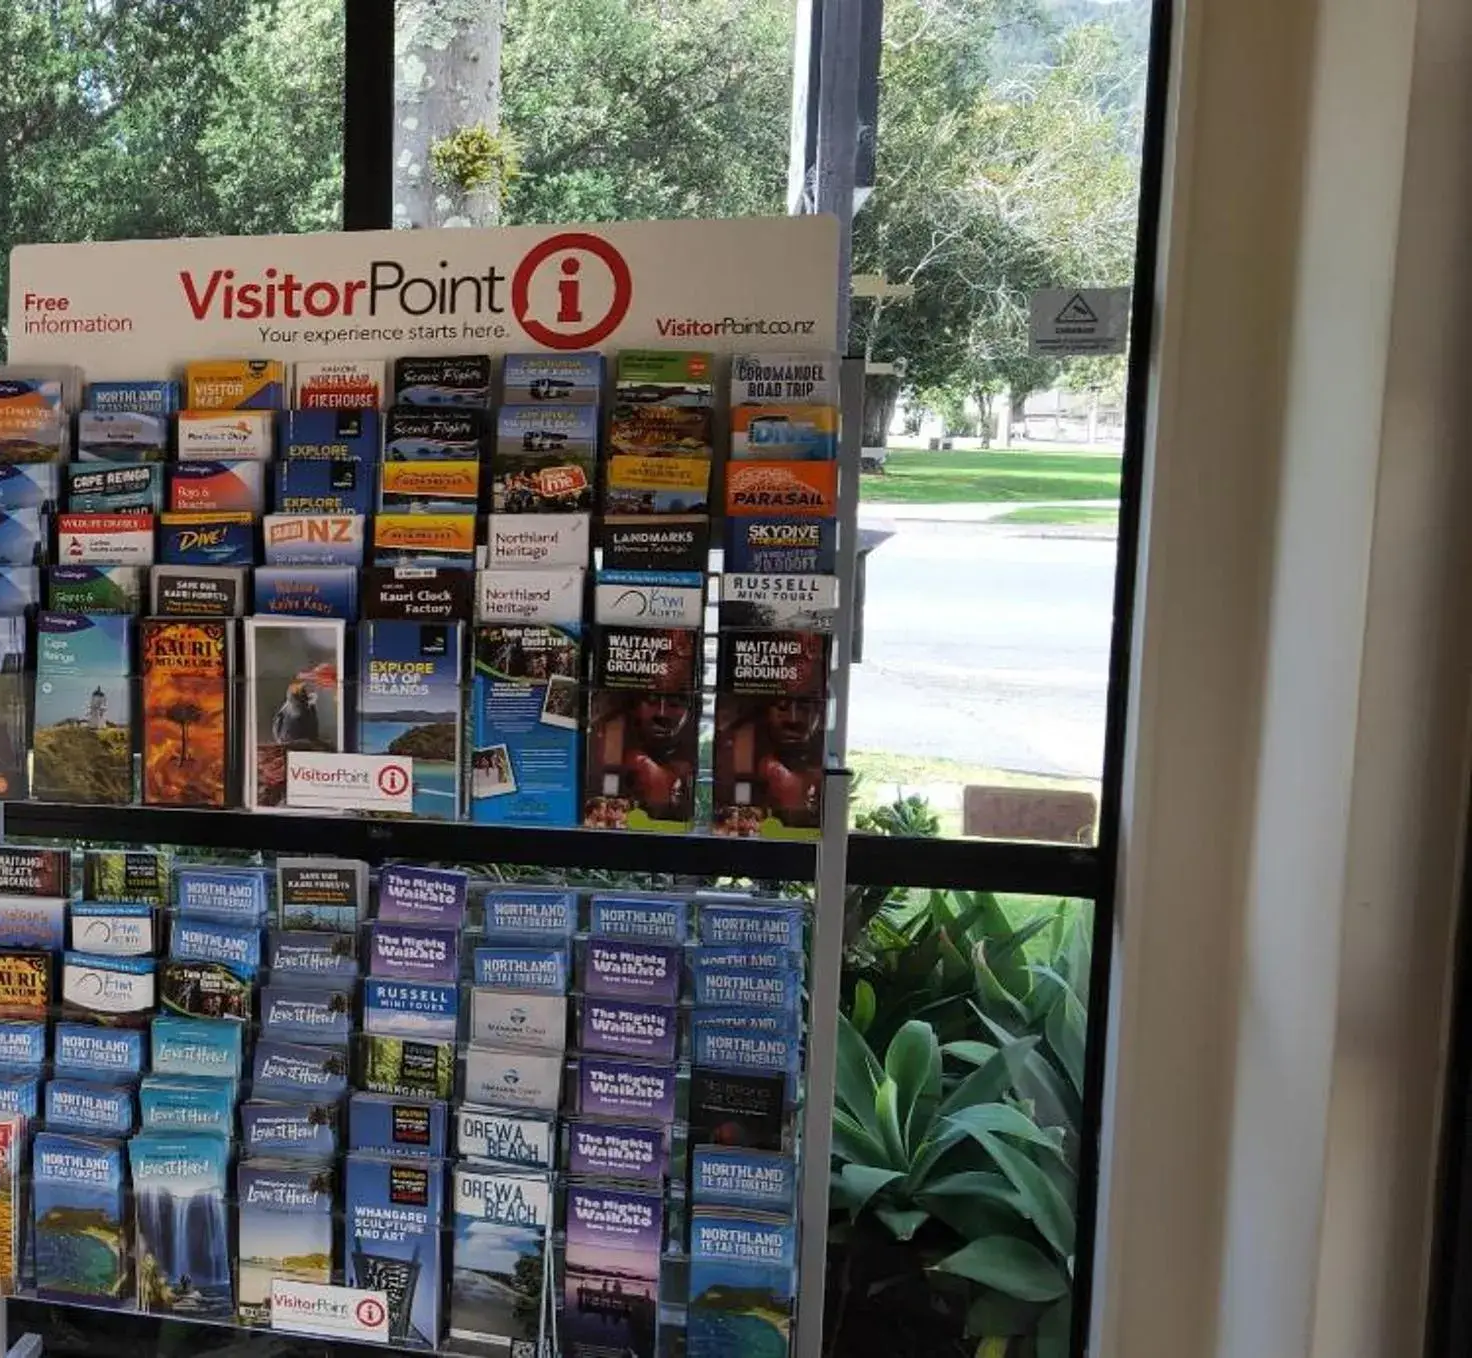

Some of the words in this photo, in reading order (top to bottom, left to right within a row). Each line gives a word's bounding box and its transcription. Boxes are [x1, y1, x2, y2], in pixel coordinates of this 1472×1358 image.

[180, 261, 505, 320] VisitorPoint
[24, 294, 70, 312] Free
[24, 315, 133, 335] information
[656, 317, 816, 337] VisitorPoint.co.nz
[259, 326, 296, 344] Your
[303, 325, 404, 345] experience
[409, 325, 458, 341] starts
[463, 323, 511, 339] here.
[403, 369, 440, 383] Scenic
[739, 365, 826, 382] COROMANDEL
[96, 390, 162, 403] NORTHLAND
[195, 383, 245, 396] VISITOR
[747, 381, 782, 397] ROAD
[787, 381, 814, 397] TRIP
[308, 394, 375, 408] FIREHOUSE
[393, 421, 430, 435] Scenic
[433, 421, 472, 439] Flights
[289, 445, 349, 456] EXPLORE
[73, 473, 104, 489] CAPE
[733, 492, 825, 506] PARASAIL
[307, 520, 353, 543] NZ
[495, 532, 559, 544] Northland
[613, 532, 694, 543] LANDMARKS
[747, 525, 820, 538] SKYDIVE
[495, 546, 549, 560] Heritage
[733, 577, 820, 591] RUSSELL
[379, 589, 413, 602] Kauri
[417, 589, 452, 602] Clock
[486, 588, 551, 602] Northland
[737, 591, 767, 600] MINI
[772, 592, 814, 601] TOURS
[405, 603, 452, 616] Factory
[486, 602, 539, 617] Heritage
[154, 640, 212, 656] KAURI
[608, 635, 672, 650] WAITANGI
[735, 641, 802, 654] WAITANGI
[154, 657, 213, 667] MUSEUM
[609, 648, 656, 660] TREATY
[736, 653, 786, 666] TREATY
[369, 661, 434, 674] EXPLORE
[607, 659, 668, 675] GROUNDS
[735, 667, 798, 680] GROUNDS
[370, 673, 398, 684] BAY
[402, 673, 422, 685] OF
[369, 684, 429, 695] ISLANDS
[290, 766, 369, 783] VisitorPoint
[186, 882, 252, 897] NORTHLAND
[388, 875, 410, 886] The
[412, 877, 455, 895] Mighty
[388, 886, 456, 904] Waikato
[494, 904, 565, 918] NORTHLAND
[600, 908, 676, 925] NORTHLAND
[712, 917, 790, 933] NORTHLAND
[377, 935, 398, 946] The
[401, 937, 446, 951] Mighty
[377, 945, 446, 961] Waikato
[592, 950, 616, 961] The
[619, 952, 666, 968] Mighty
[484, 959, 556, 974] NORTHLAND
[592, 961, 666, 977] Waikato
[706, 975, 784, 992] NORTHLAND
[377, 986, 448, 1003] RUSSELL
[706, 990, 716, 1000] TE
[719, 989, 734, 1000] TAI
[381, 1000, 406, 1010] MINI
[412, 1002, 445, 1012] TOURS
[592, 1008, 616, 1020] The
[619, 1010, 665, 1028] Mighty
[592, 1019, 666, 1037] Waikato
[62, 1036, 129, 1052] NORTHLAND
[706, 1035, 786, 1054] NORTHLAND
[590, 1071, 615, 1082] The
[618, 1073, 665, 1089] Mighty
[590, 1081, 664, 1099] Waikato
[53, 1092, 119, 1111] NORTHLAND
[463, 1119, 523, 1141] OREWA
[488, 1139, 538, 1161] BEACH
[578, 1133, 603, 1145] The
[605, 1135, 652, 1152] Mighty
[579, 1144, 653, 1162] Waikato
[42, 1153, 109, 1171] NORTHLAND
[702, 1161, 784, 1181] NORTHLAND
[461, 1178, 523, 1201] OREWA
[355, 1206, 427, 1223] WHANGAREI
[484, 1199, 537, 1224] BEACH
[575, 1197, 600, 1208] The
[603, 1199, 652, 1216] Mighty
[575, 1207, 652, 1227] Waikato
[355, 1218, 426, 1234] SCULPTURE
[355, 1228, 380, 1239] AND
[382, 1230, 405, 1241] ART
[701, 1227, 783, 1247] NORTHLAND
[273, 1292, 349, 1316] VisitorPoint
